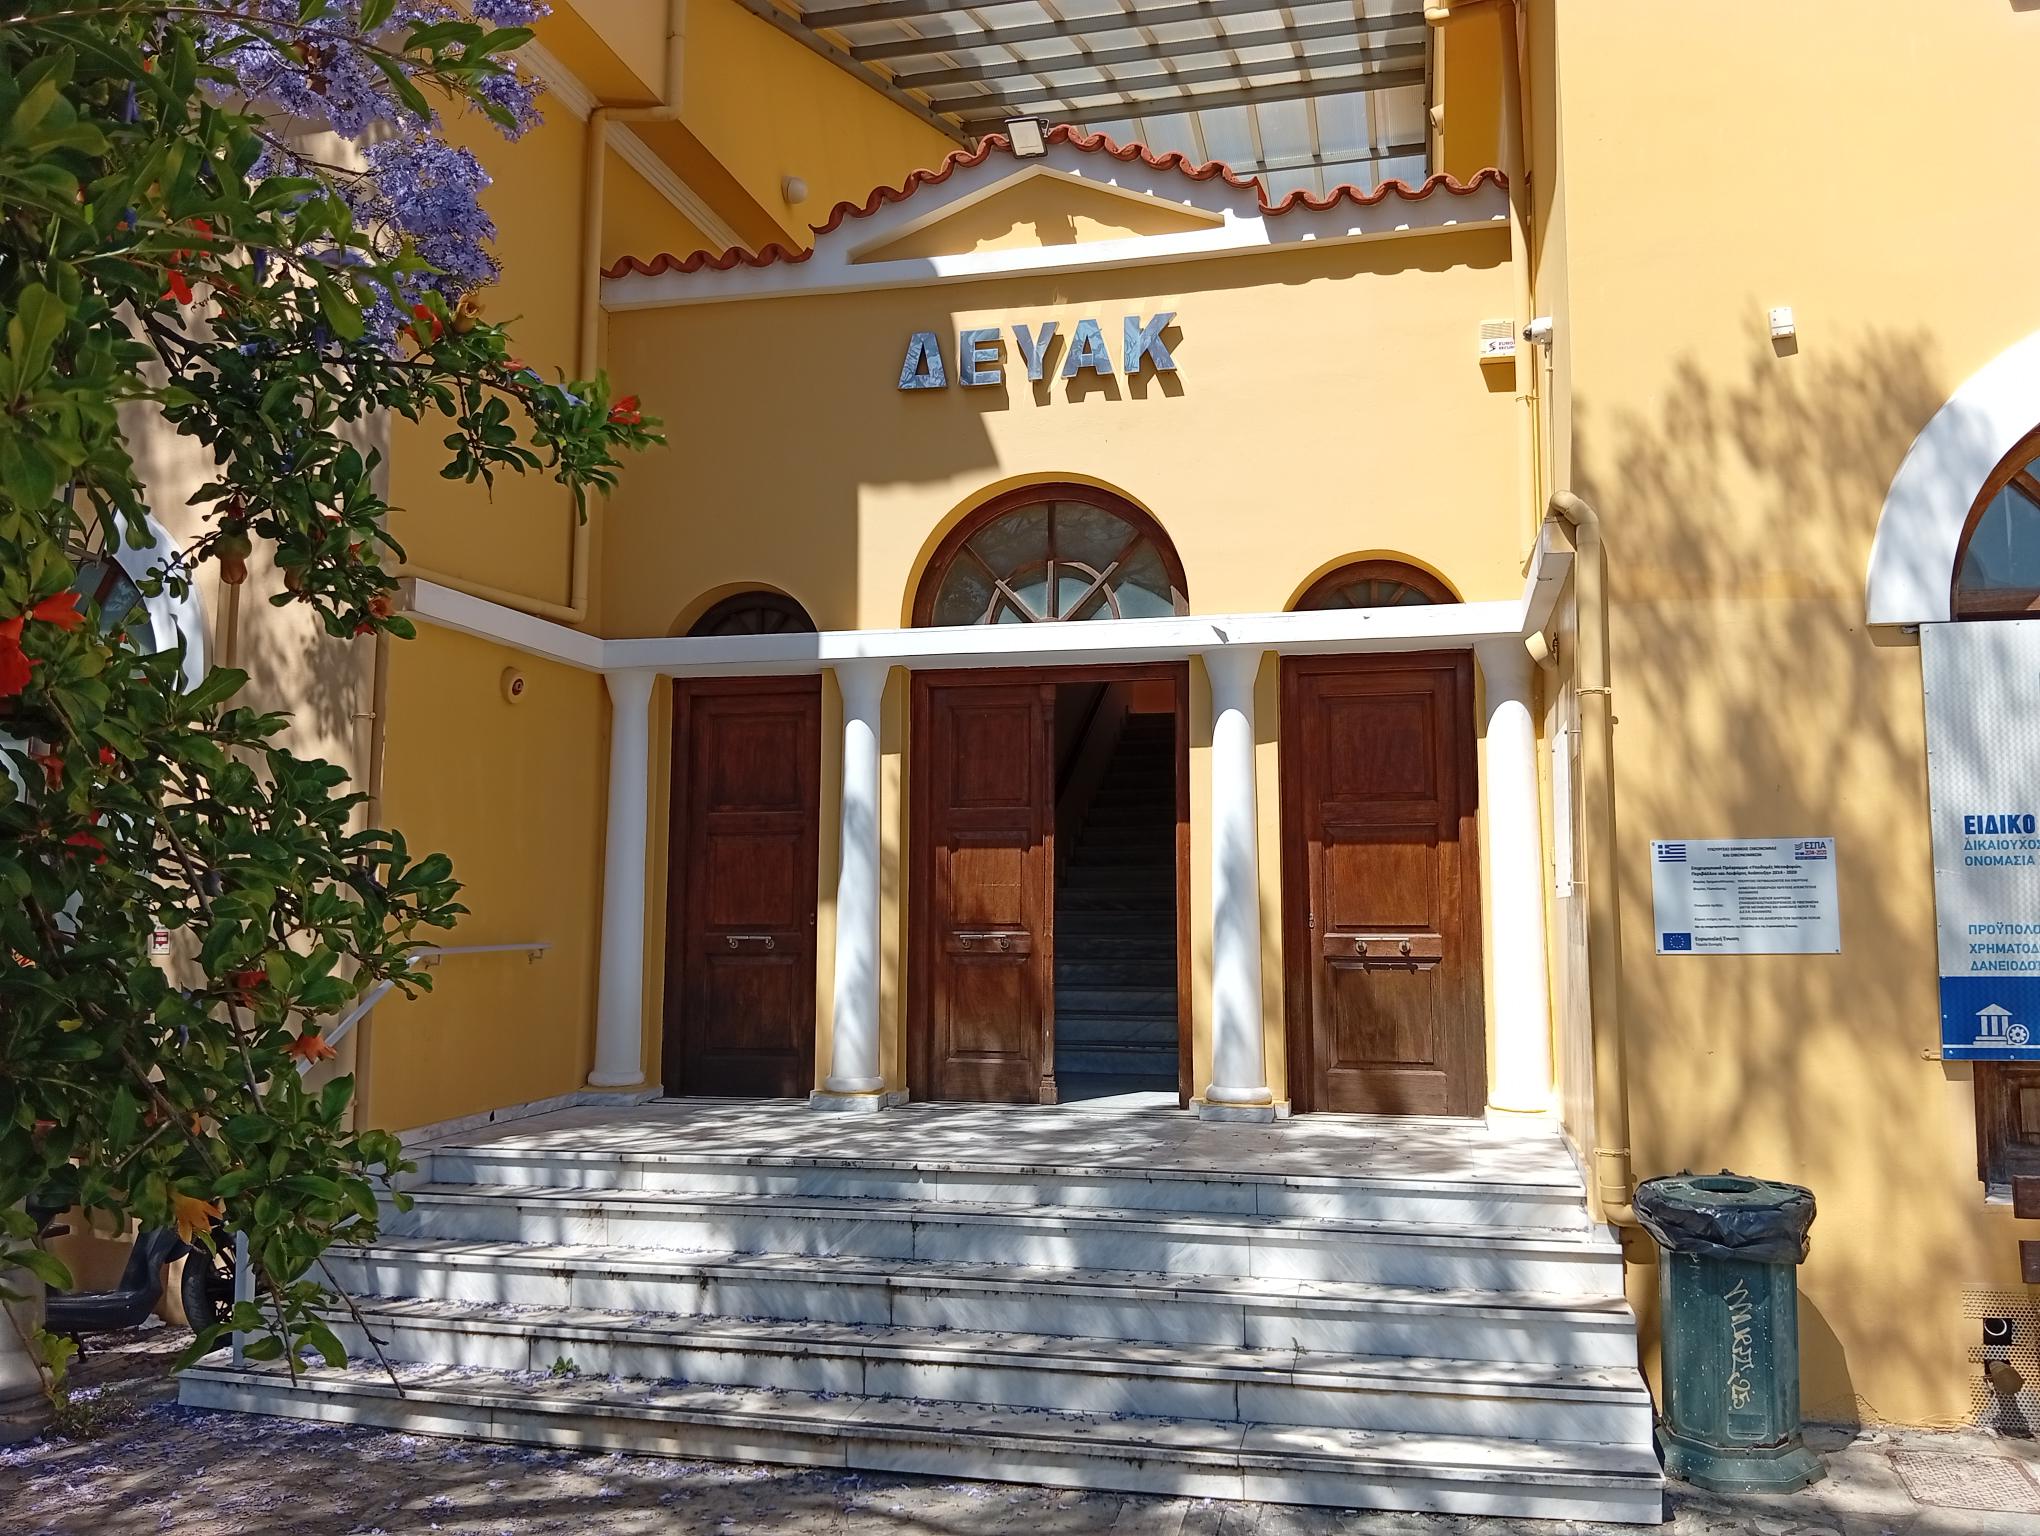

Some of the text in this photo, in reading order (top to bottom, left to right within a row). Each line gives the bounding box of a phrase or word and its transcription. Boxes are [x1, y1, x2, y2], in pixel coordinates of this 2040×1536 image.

[898, 311, 1177, 392] ΔΕΥΑΚ
[1964, 814, 2036, 835] ΕΙΔΙΚΟ
[1804, 841, 1827, 849] ΕΣΠΑ
[1964, 855, 2036, 866] ΟΝΟΜΑΣΙΑ
[1968, 943, 2040, 954] ΧΡΗΜΑΤΟΔ
